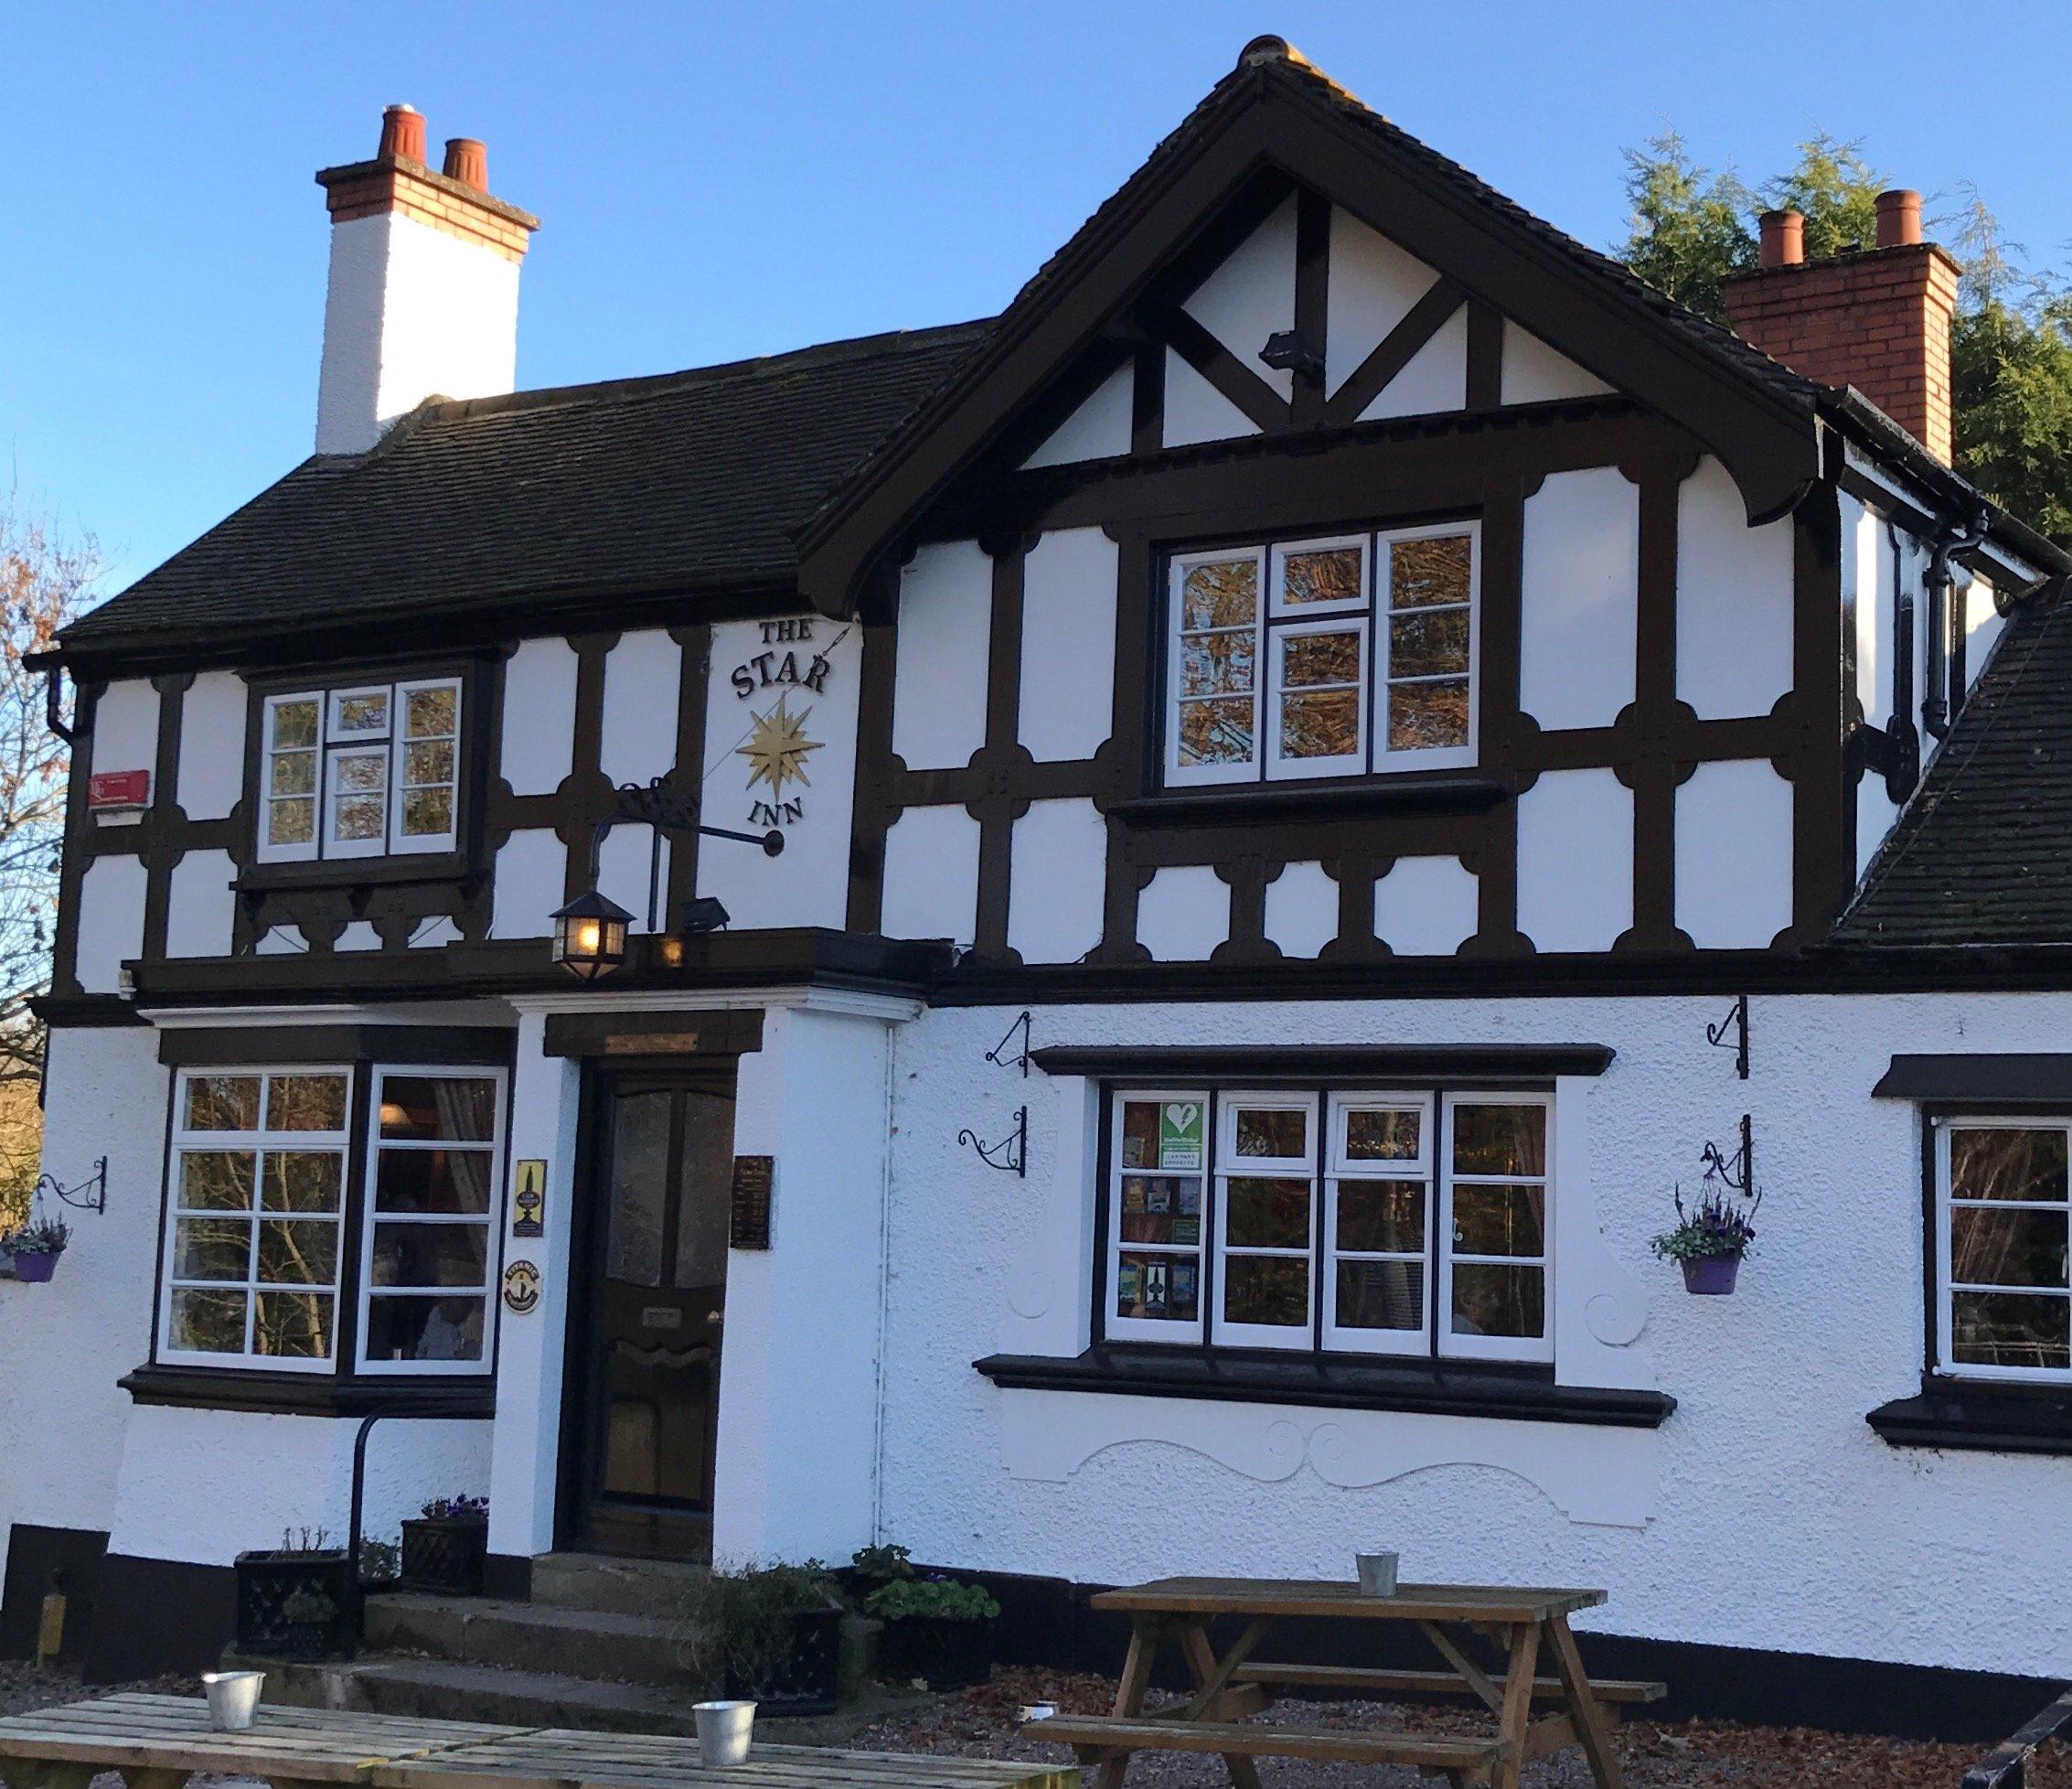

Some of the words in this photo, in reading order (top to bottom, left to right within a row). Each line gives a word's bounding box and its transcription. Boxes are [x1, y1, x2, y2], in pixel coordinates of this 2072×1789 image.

[759, 619, 813, 644] THE
[732, 651, 830, 699] STAR
[747, 797, 804, 826] INN
